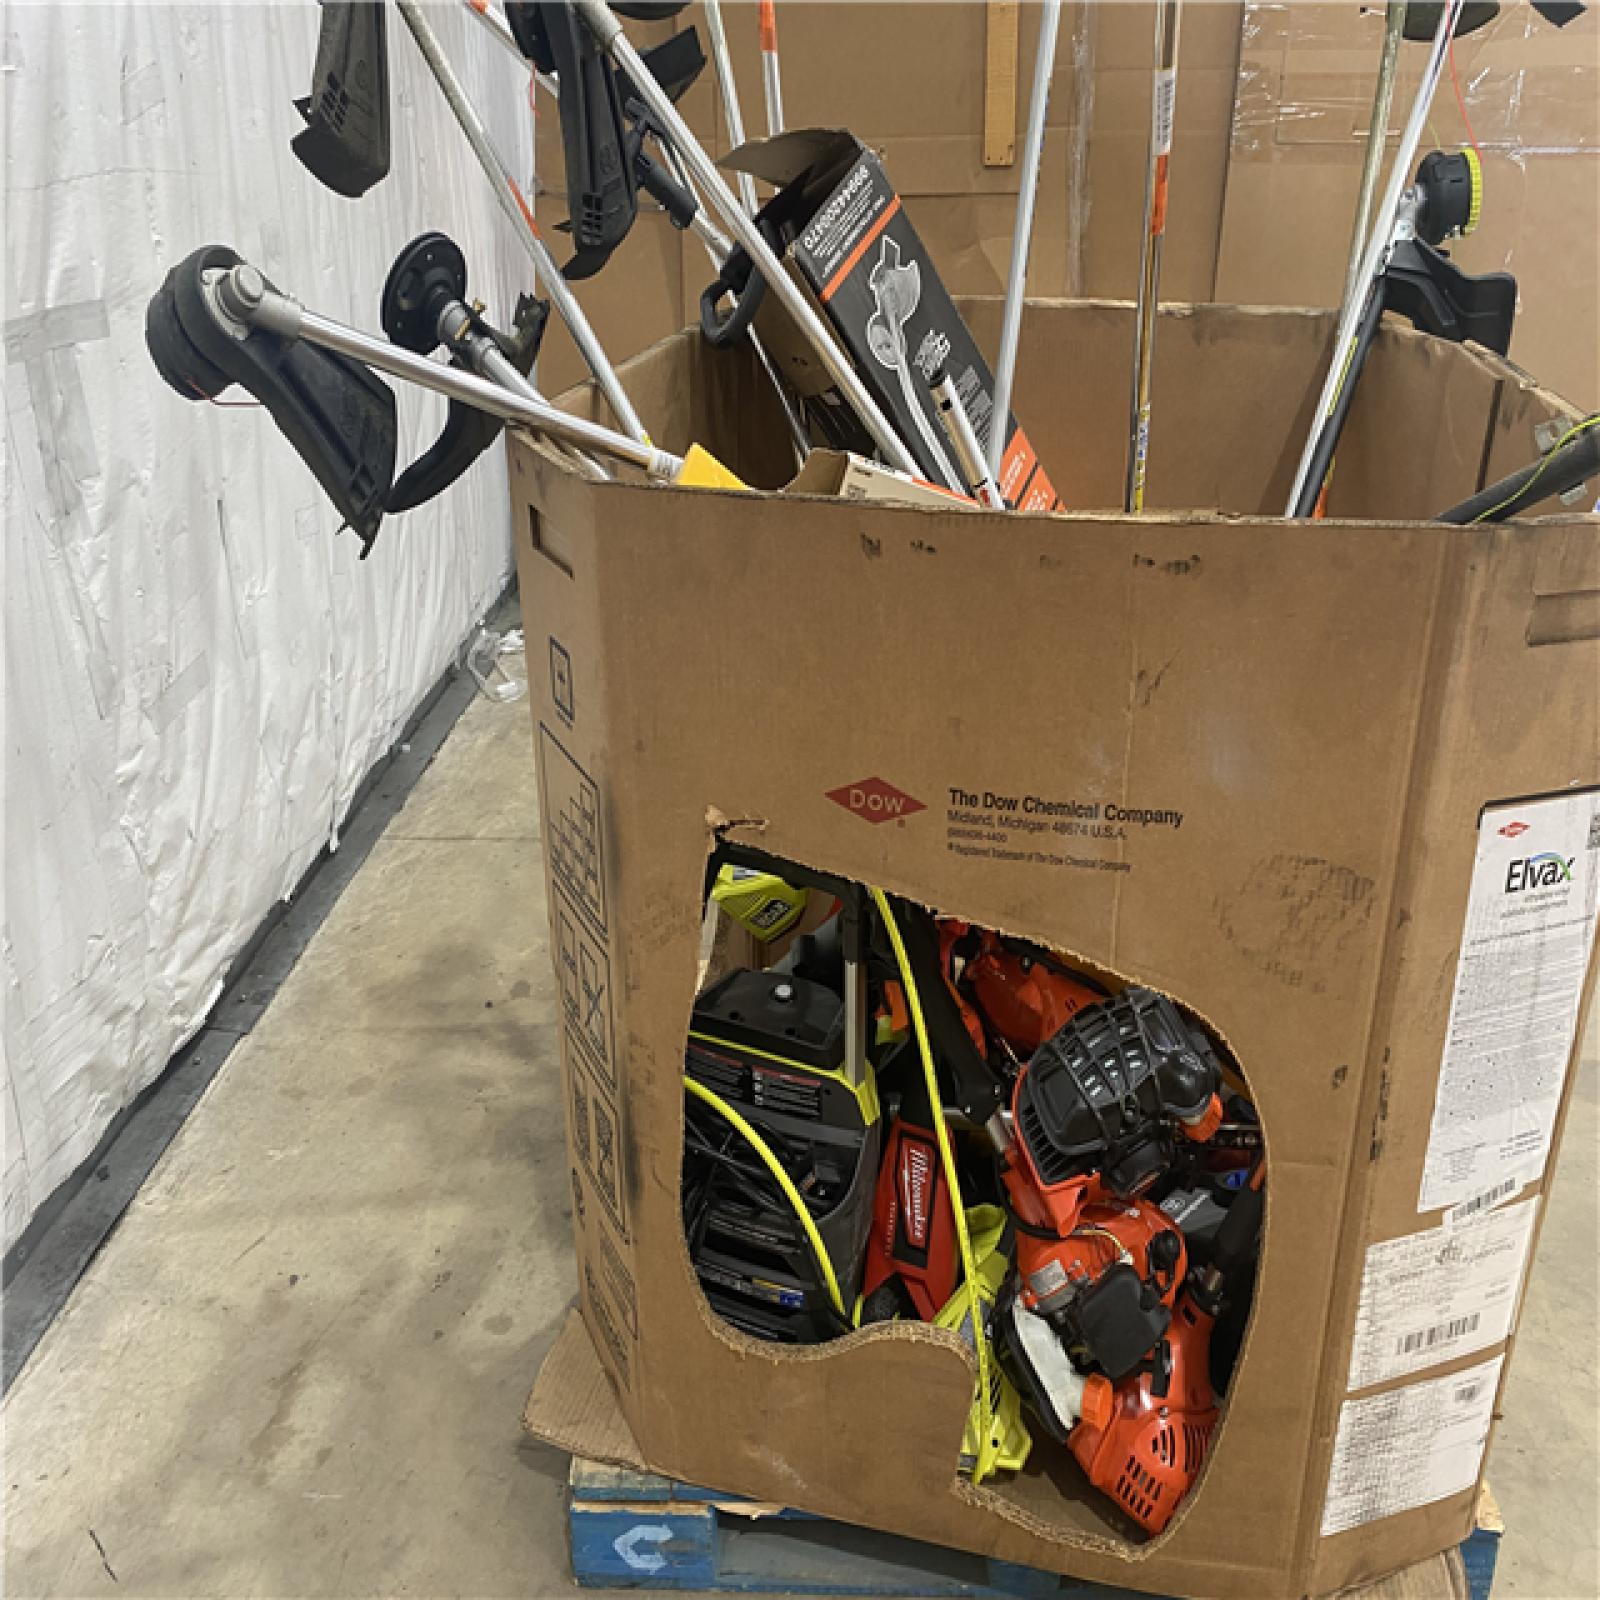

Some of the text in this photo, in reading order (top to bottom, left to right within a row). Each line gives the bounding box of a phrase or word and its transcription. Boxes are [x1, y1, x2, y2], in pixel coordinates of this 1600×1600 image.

[949, 788, 1184, 829] The Dow Chemical Company
[1505, 854, 1576, 893] Elvax
[909, 1148, 928, 1239] Milwaukee
